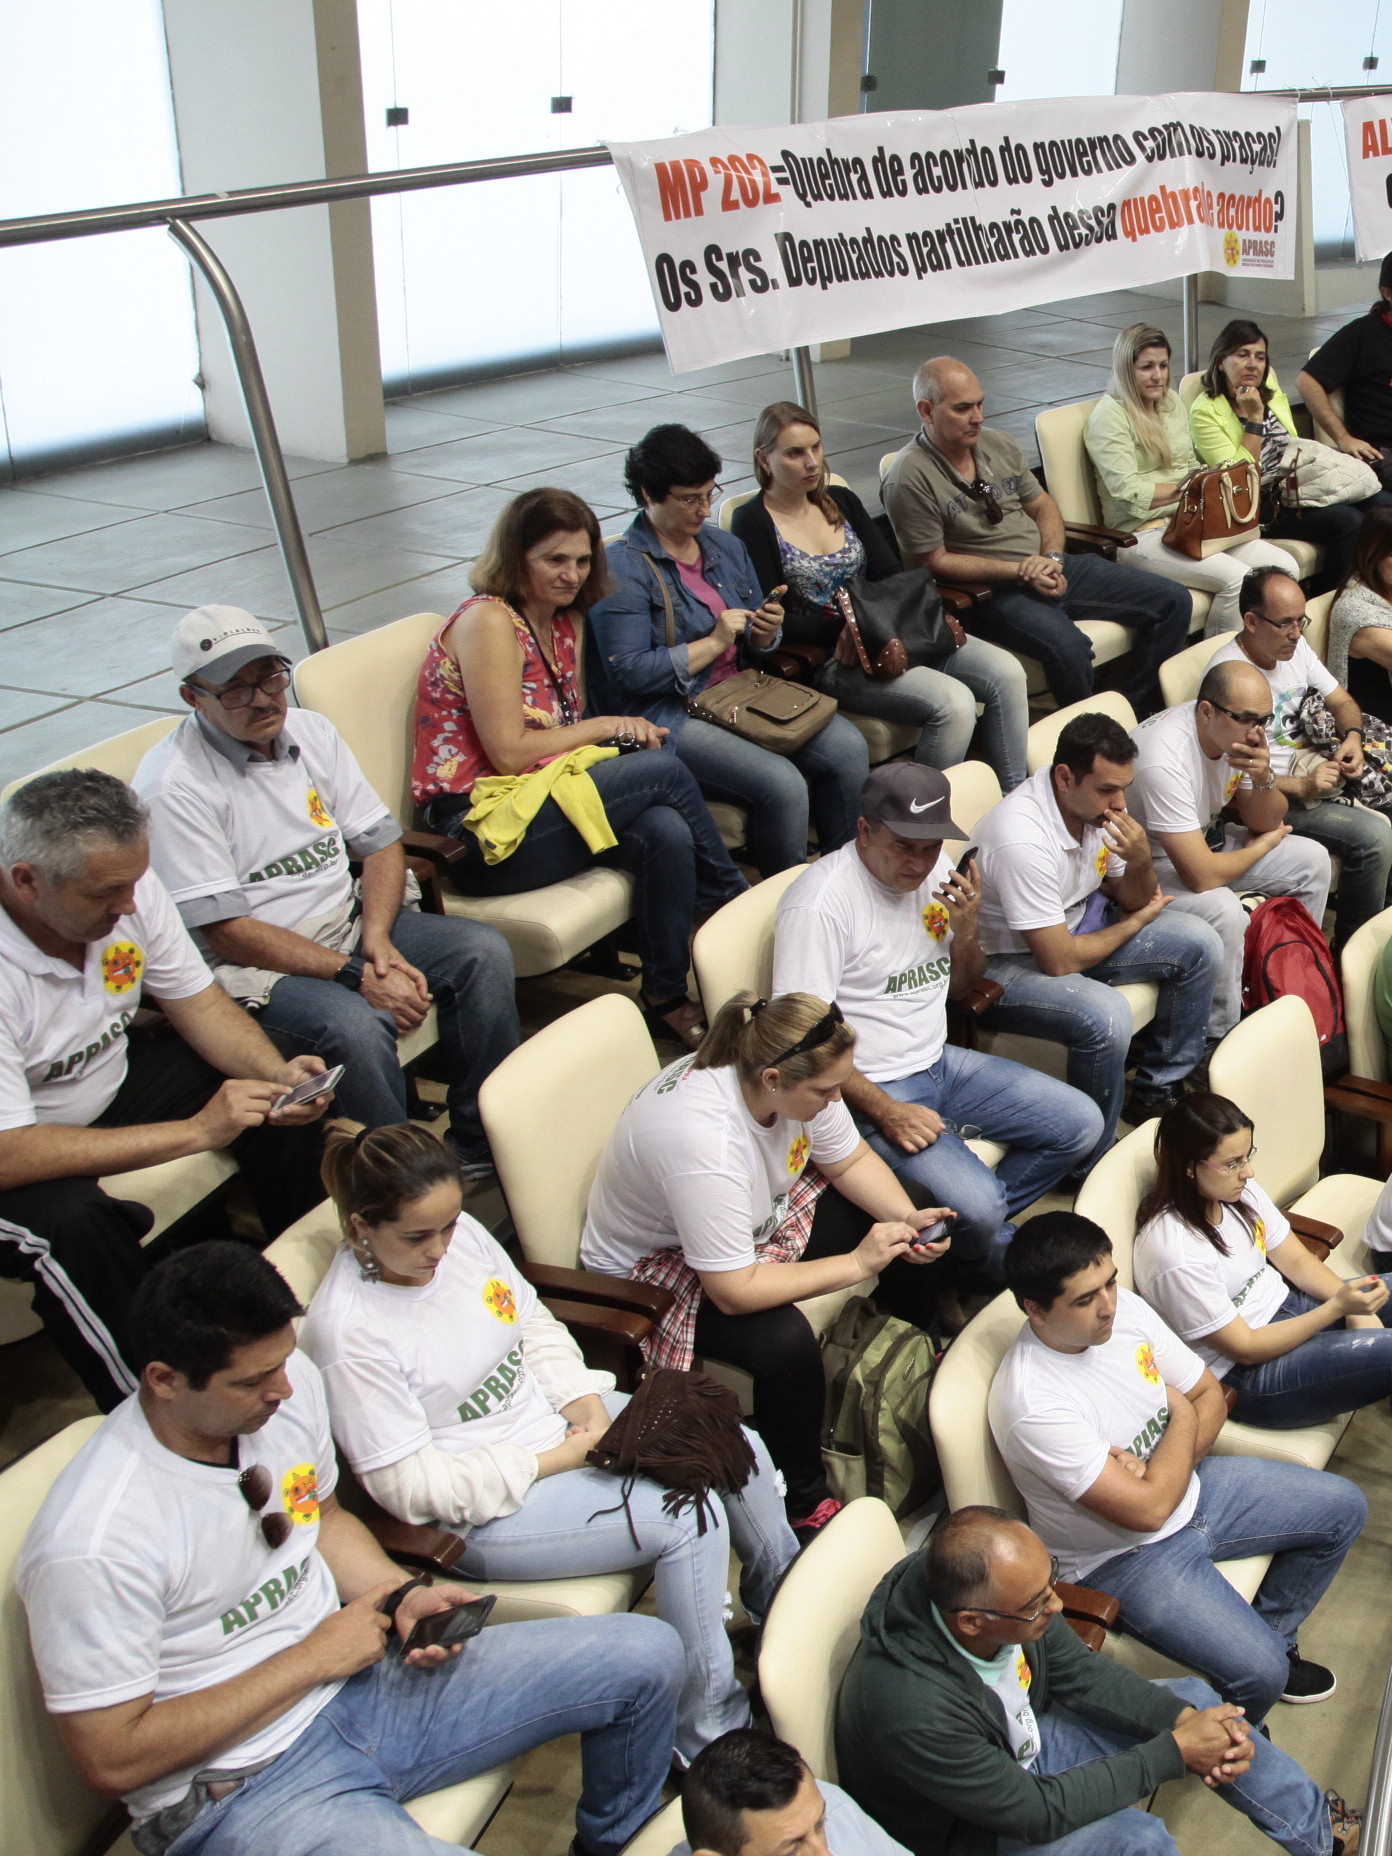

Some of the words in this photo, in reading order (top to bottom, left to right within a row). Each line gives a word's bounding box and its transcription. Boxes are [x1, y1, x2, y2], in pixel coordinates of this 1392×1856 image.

[653, 158, 709, 222] MP
[871, 145, 909, 199] de
[909, 138, 999, 196] acordo
[998, 135, 1034, 186] do
[1032, 132, 1137, 188] governo
[1132, 120, 1193, 164] com
[1188, 123, 1217, 161] os
[1211, 125, 1282, 176] praças!
[654, 252, 704, 313] Os
[703, 243, 780, 303] Srs.
[773, 226, 910, 291] Deputados
[904, 206, 1050, 281] partilharão
[1047, 202, 1118, 253] dessa
[1120, 184, 1205, 243] quebra
[1216, 188, 1285, 234] acordo?
[1241, 238, 1276, 258] APRASC
[884, 956, 951, 995] APRASC
[457, 1338, 524, 1422] APRAS
